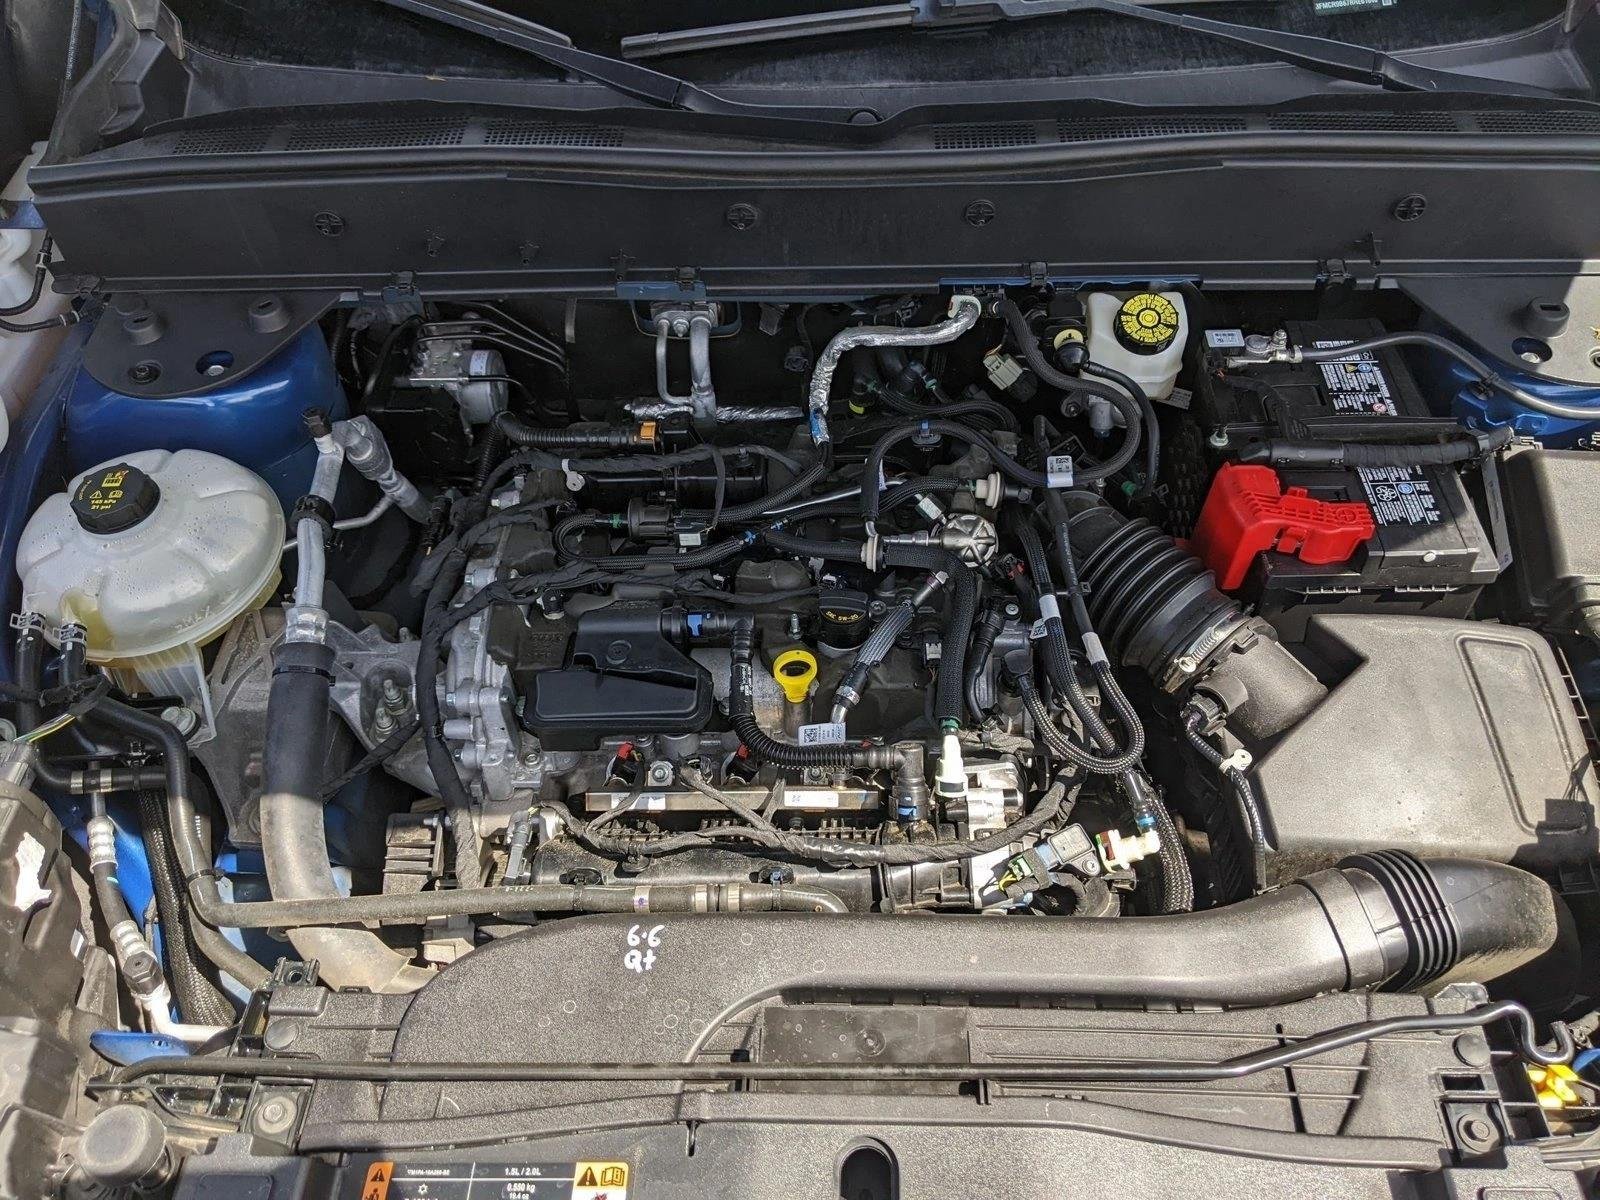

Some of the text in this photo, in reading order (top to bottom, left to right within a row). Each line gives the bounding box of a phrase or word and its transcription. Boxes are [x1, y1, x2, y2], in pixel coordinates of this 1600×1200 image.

[627, 924, 665, 948] 6.6
[624, 948, 657, 973] Qt
[505, 1167, 520, 1176] 1.5L
[525, 1167, 542, 1176] 2.0L
[526, 1182, 536, 1194] kg
